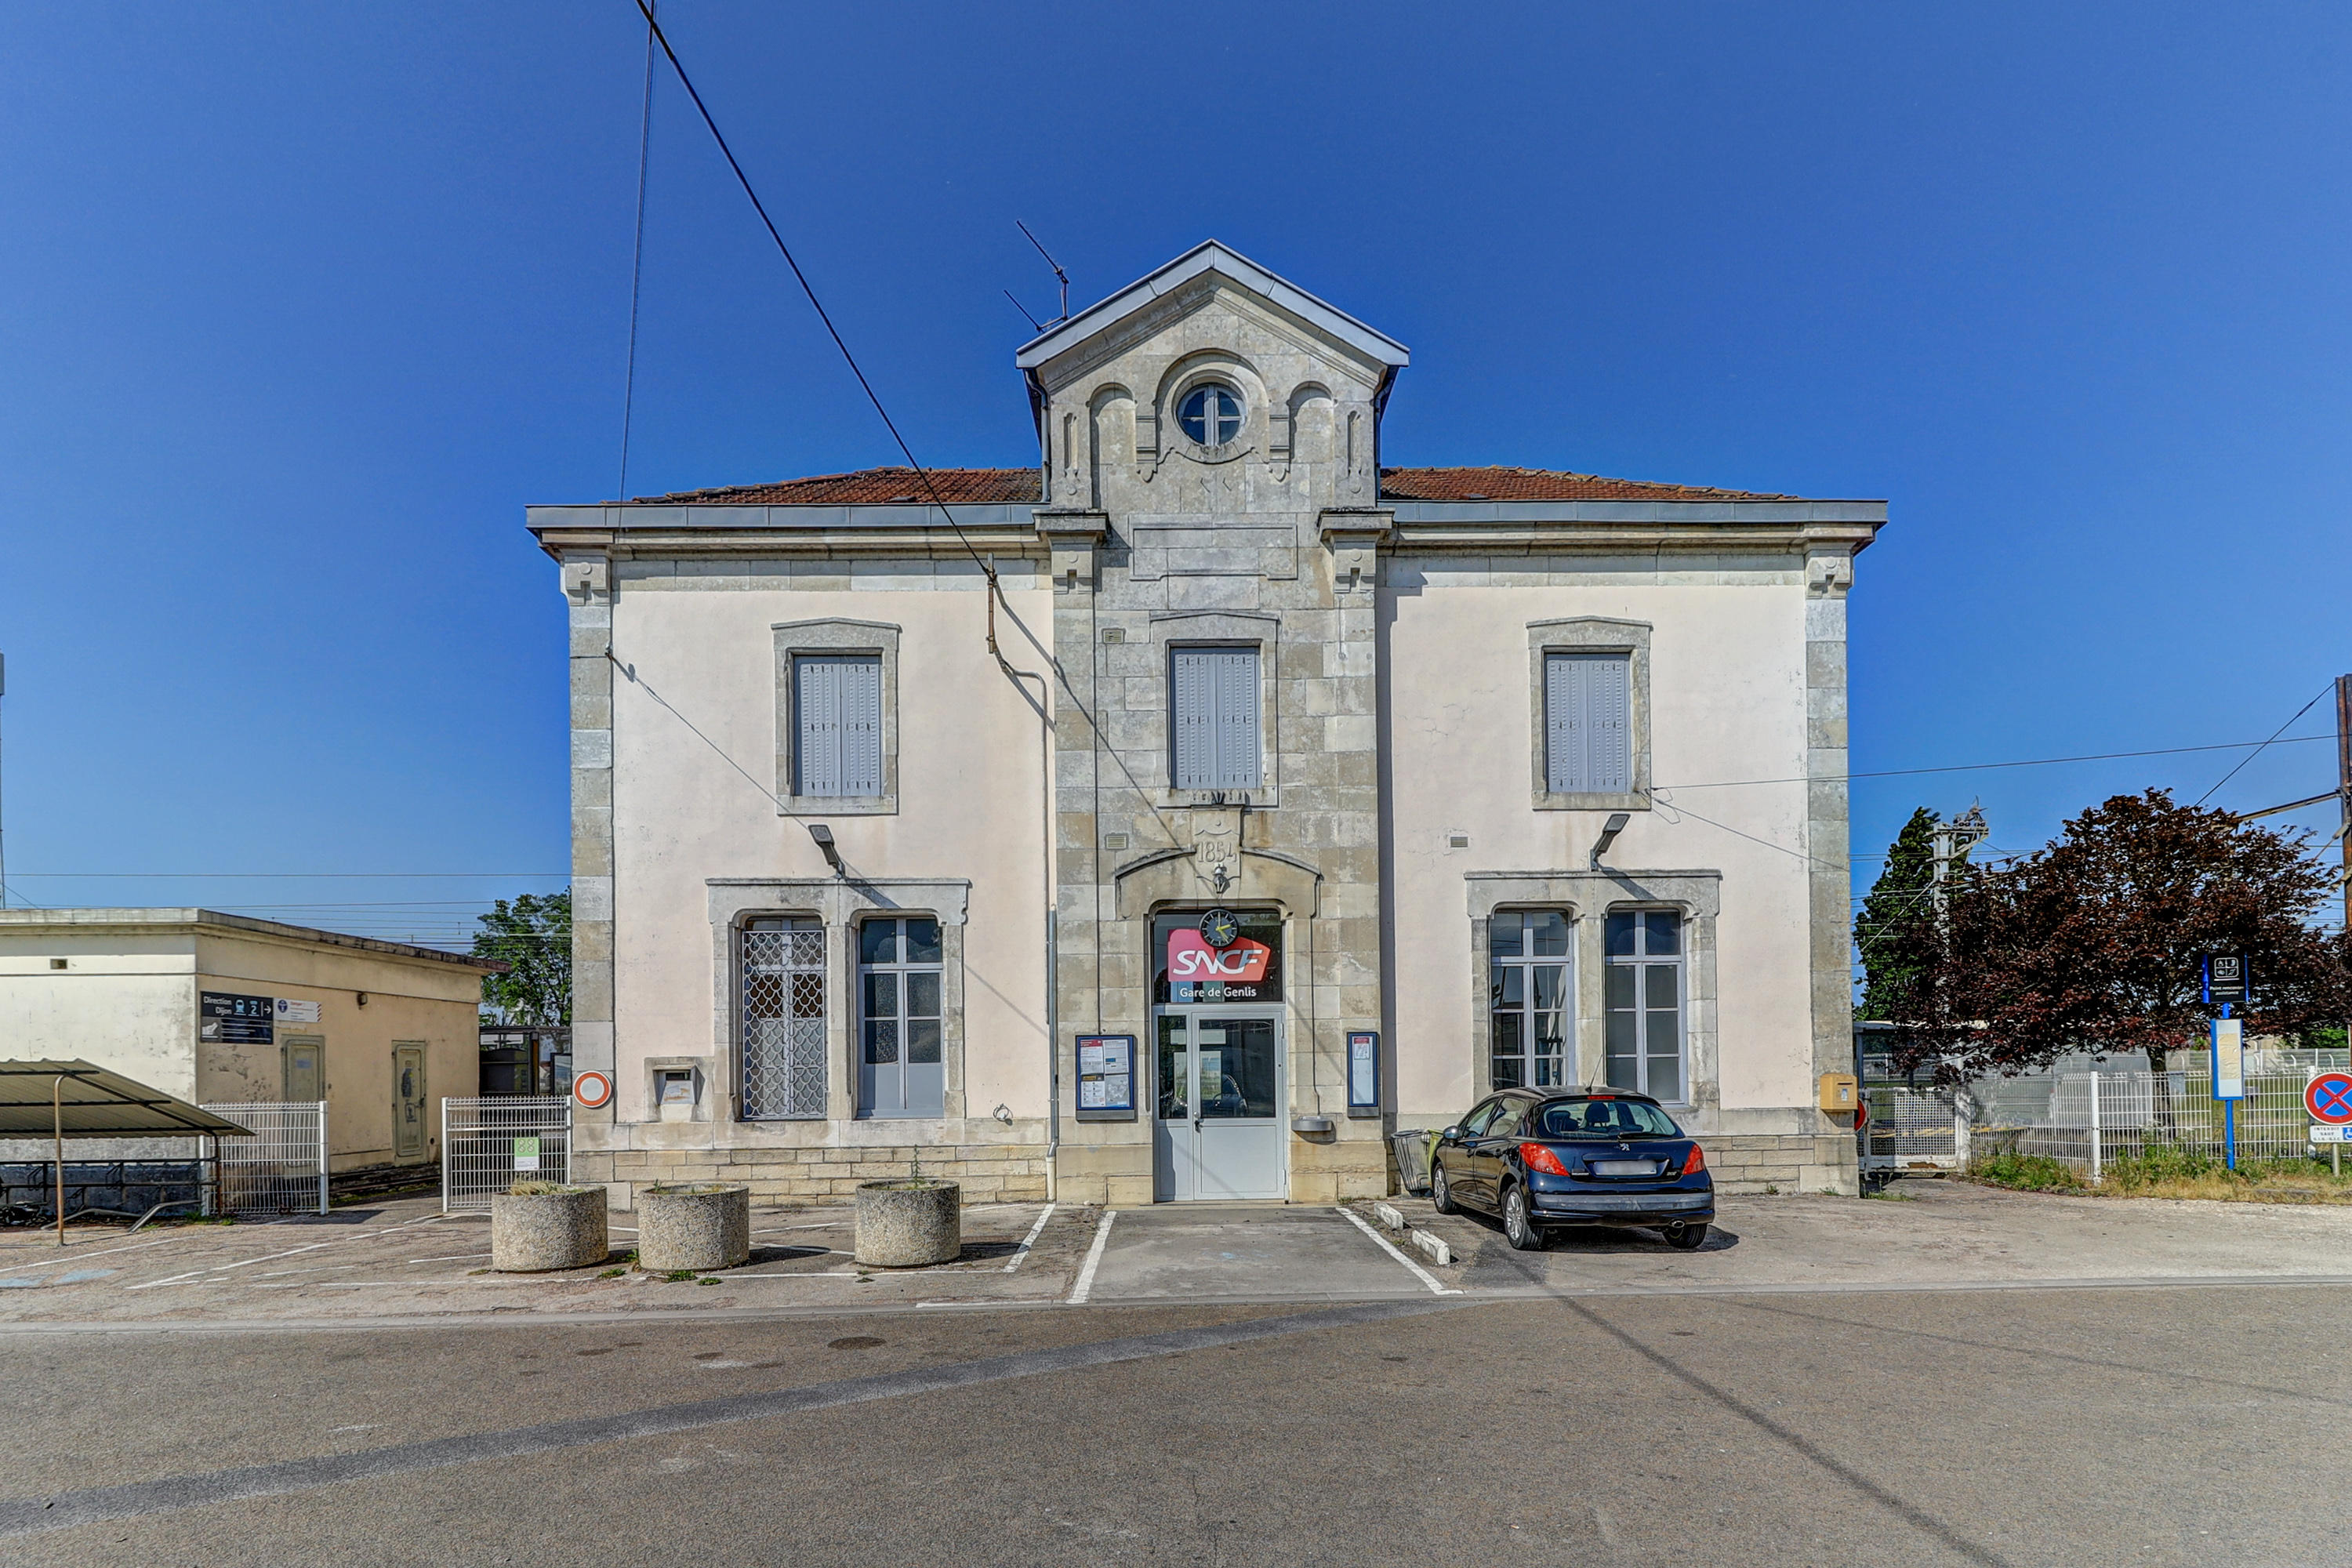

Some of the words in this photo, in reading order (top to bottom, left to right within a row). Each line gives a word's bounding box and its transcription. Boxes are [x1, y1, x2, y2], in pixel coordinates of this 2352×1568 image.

[1197, 840, 1237, 862] 1854
[1172, 949, 1263, 975] SNCF
[1179, 988, 1205, 997] Gare
[1207, 987, 1221, 997] de
[1223, 986, 1257, 997] Genlis
[203, 996, 232, 1006] Direction
[251, 1005, 257, 1014] 2
[215, 1006, 232, 1016] Dijon
